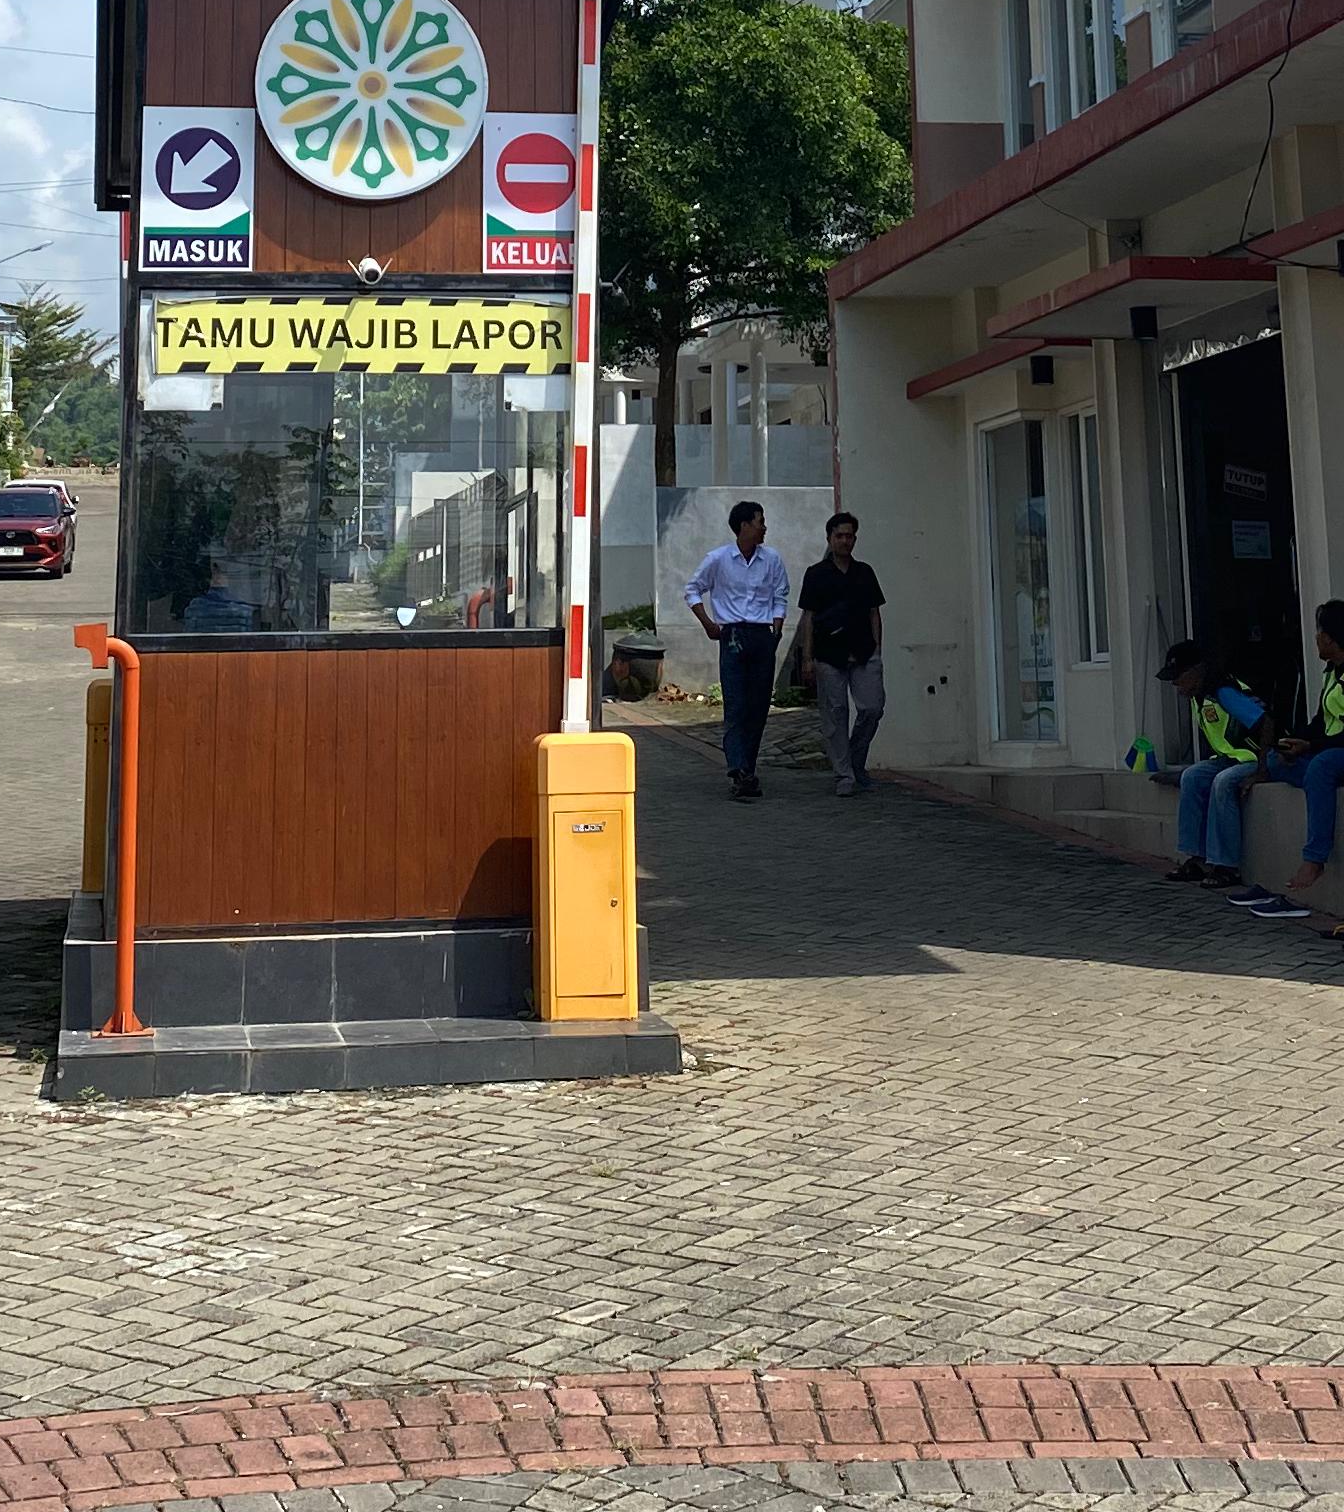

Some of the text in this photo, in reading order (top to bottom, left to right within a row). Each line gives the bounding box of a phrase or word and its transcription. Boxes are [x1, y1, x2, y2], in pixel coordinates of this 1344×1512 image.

[148, 239, 244, 263] MASUK
[491, 241, 575, 265] KELUA
[156, 317, 563, 350] TAMU WAJIB LAPOR
